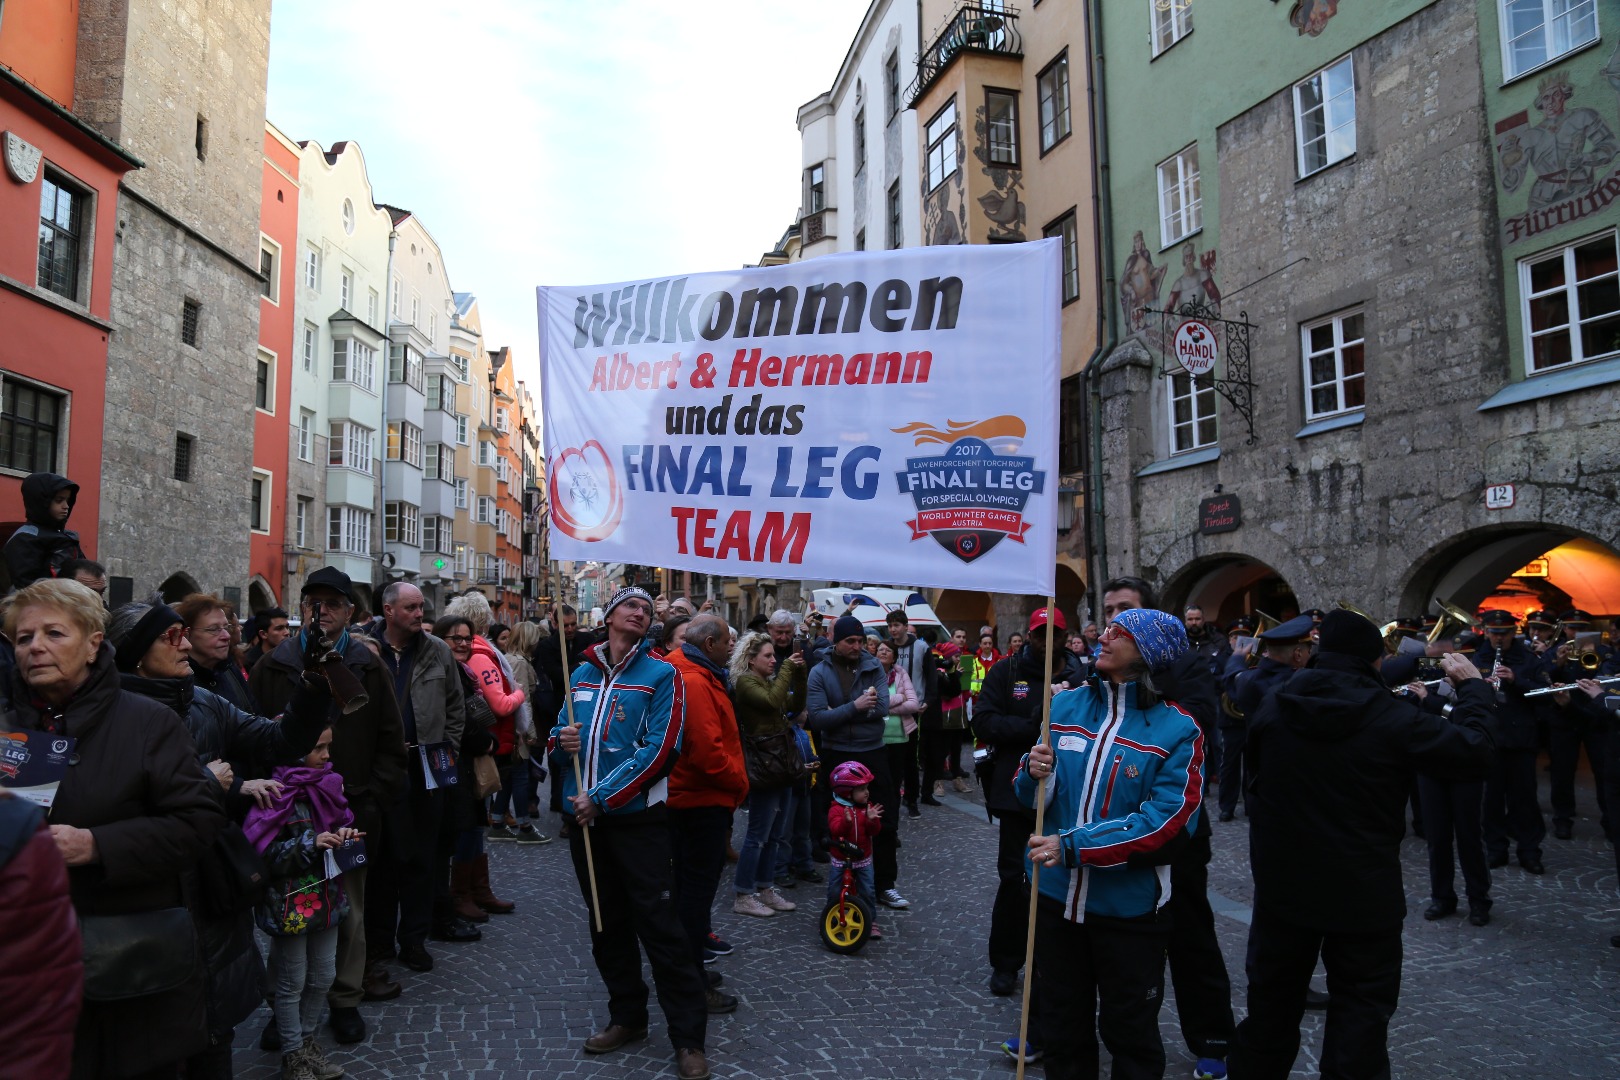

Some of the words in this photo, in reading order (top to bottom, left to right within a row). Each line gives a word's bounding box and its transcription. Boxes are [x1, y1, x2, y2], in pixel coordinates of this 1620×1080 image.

[1504, 169, 1620, 244] Fürrutte
[574, 275, 963, 350] Willkommen
[1180, 340, 1214, 359] HANDL
[590, 353, 682, 392] Albert
[690, 352, 717, 389] &
[728, 349, 933, 388] Hermann
[1182, 353, 1209, 370] Tyrol
[666, 394, 733, 435] und
[734, 393, 806, 435] das
[955, 446, 981, 456] 2017
[622, 445, 753, 497] FINAL
[770, 445, 882, 500] LEG
[929, 460, 982, 468] ENFORCEMENT
[907, 470, 978, 491] FINAL
[985, 470, 1034, 491] LEG
[921, 496, 940, 505] FOR
[940, 494, 974, 503] SPECIAL
[975, 494, 1019, 506] OLYMPICS
[1492, 486, 1507, 501] 12
[921, 512, 952, 521] WORLD
[953, 511, 986, 519] WINTER
[988, 512, 1017, 523] GAMES
[671, 507, 812, 565] TEAM
[481, 669, 500, 685] 23
[6, 750, 25, 760] LEG
